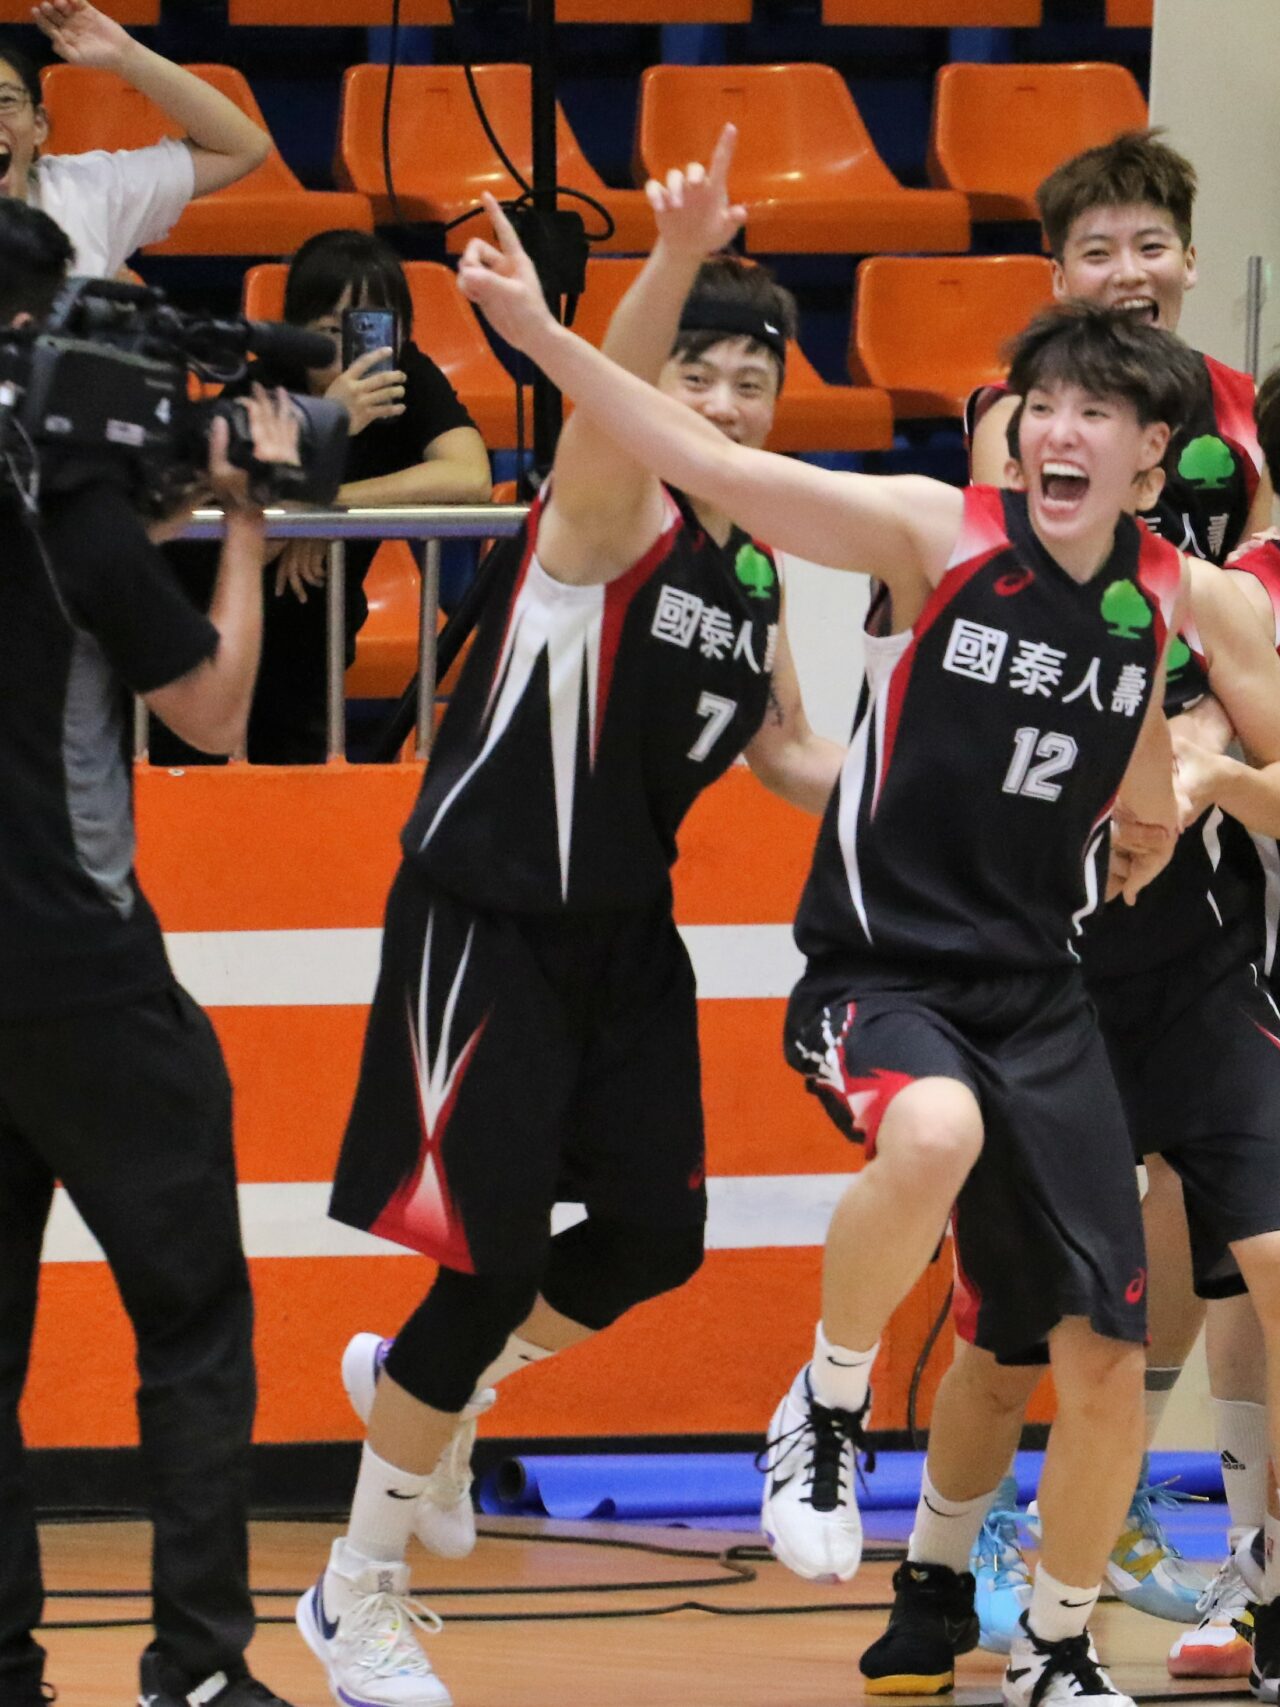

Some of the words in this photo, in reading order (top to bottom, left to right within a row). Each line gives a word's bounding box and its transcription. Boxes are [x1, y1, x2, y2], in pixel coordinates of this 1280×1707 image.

[942, 617, 1147, 717] 國泰人壽
[686, 690, 738, 762] 7
[1001, 726, 1079, 802] 12
